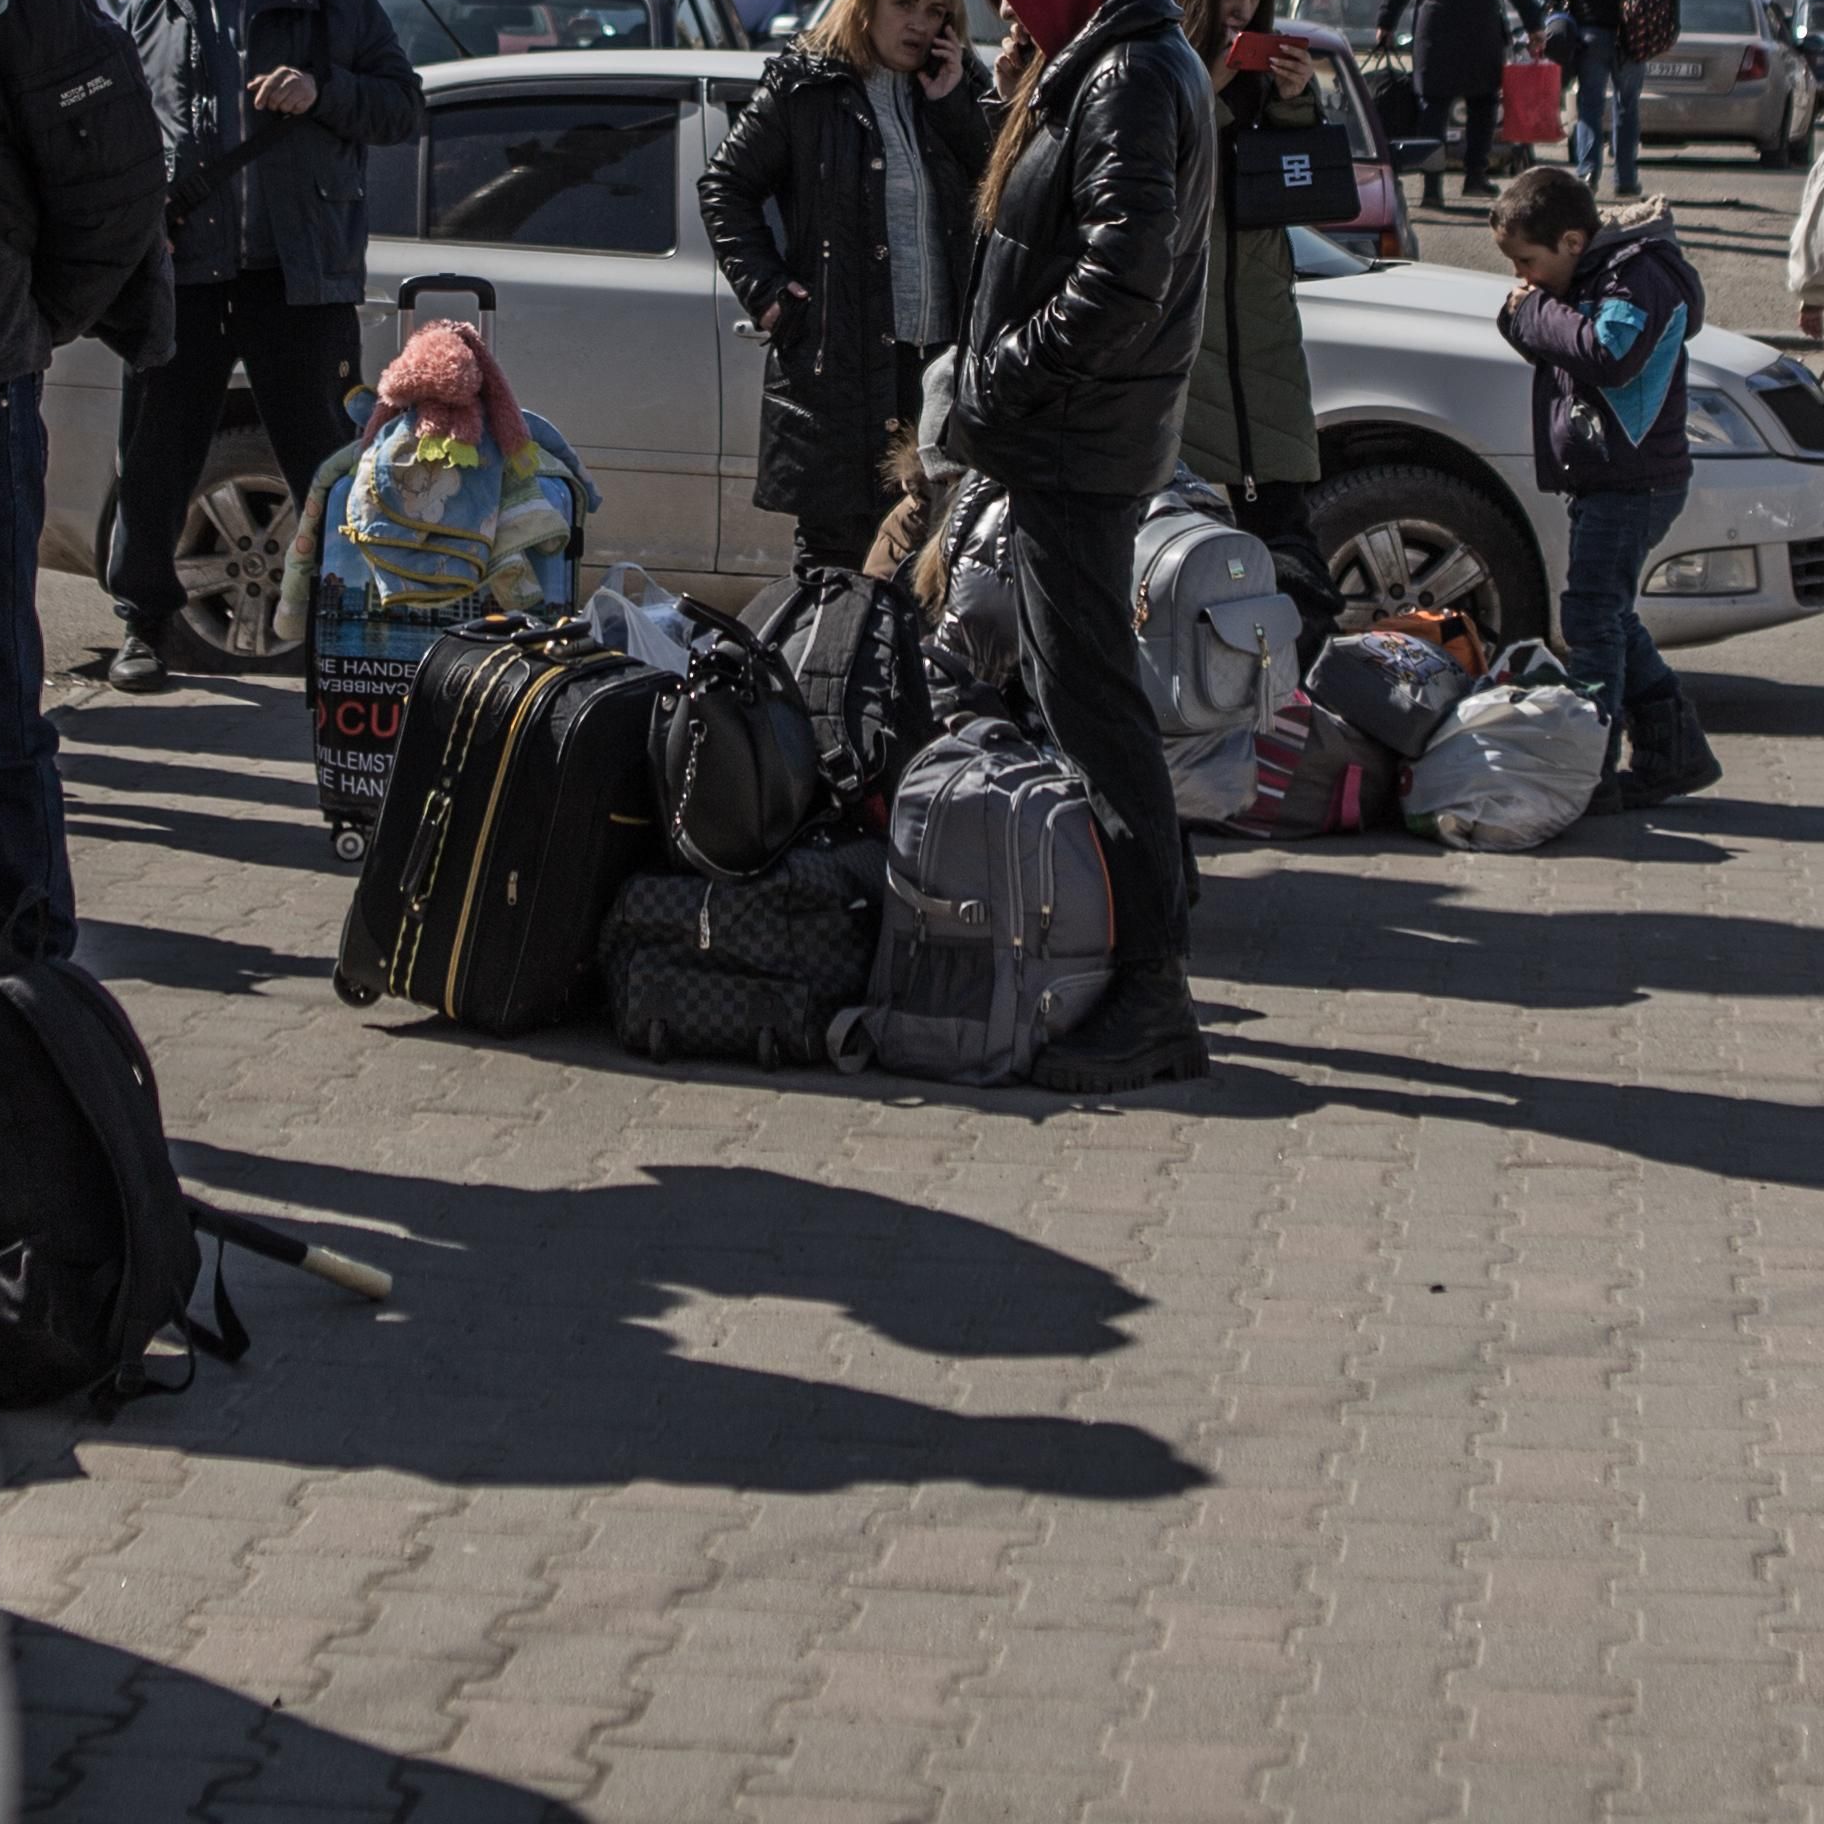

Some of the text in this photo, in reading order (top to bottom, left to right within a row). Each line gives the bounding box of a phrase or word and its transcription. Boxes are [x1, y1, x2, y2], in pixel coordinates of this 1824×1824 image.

[60, 85, 85, 99] MOTOR
[343, 660, 417, 679] HANDE
[341, 773, 389, 798] HAN
